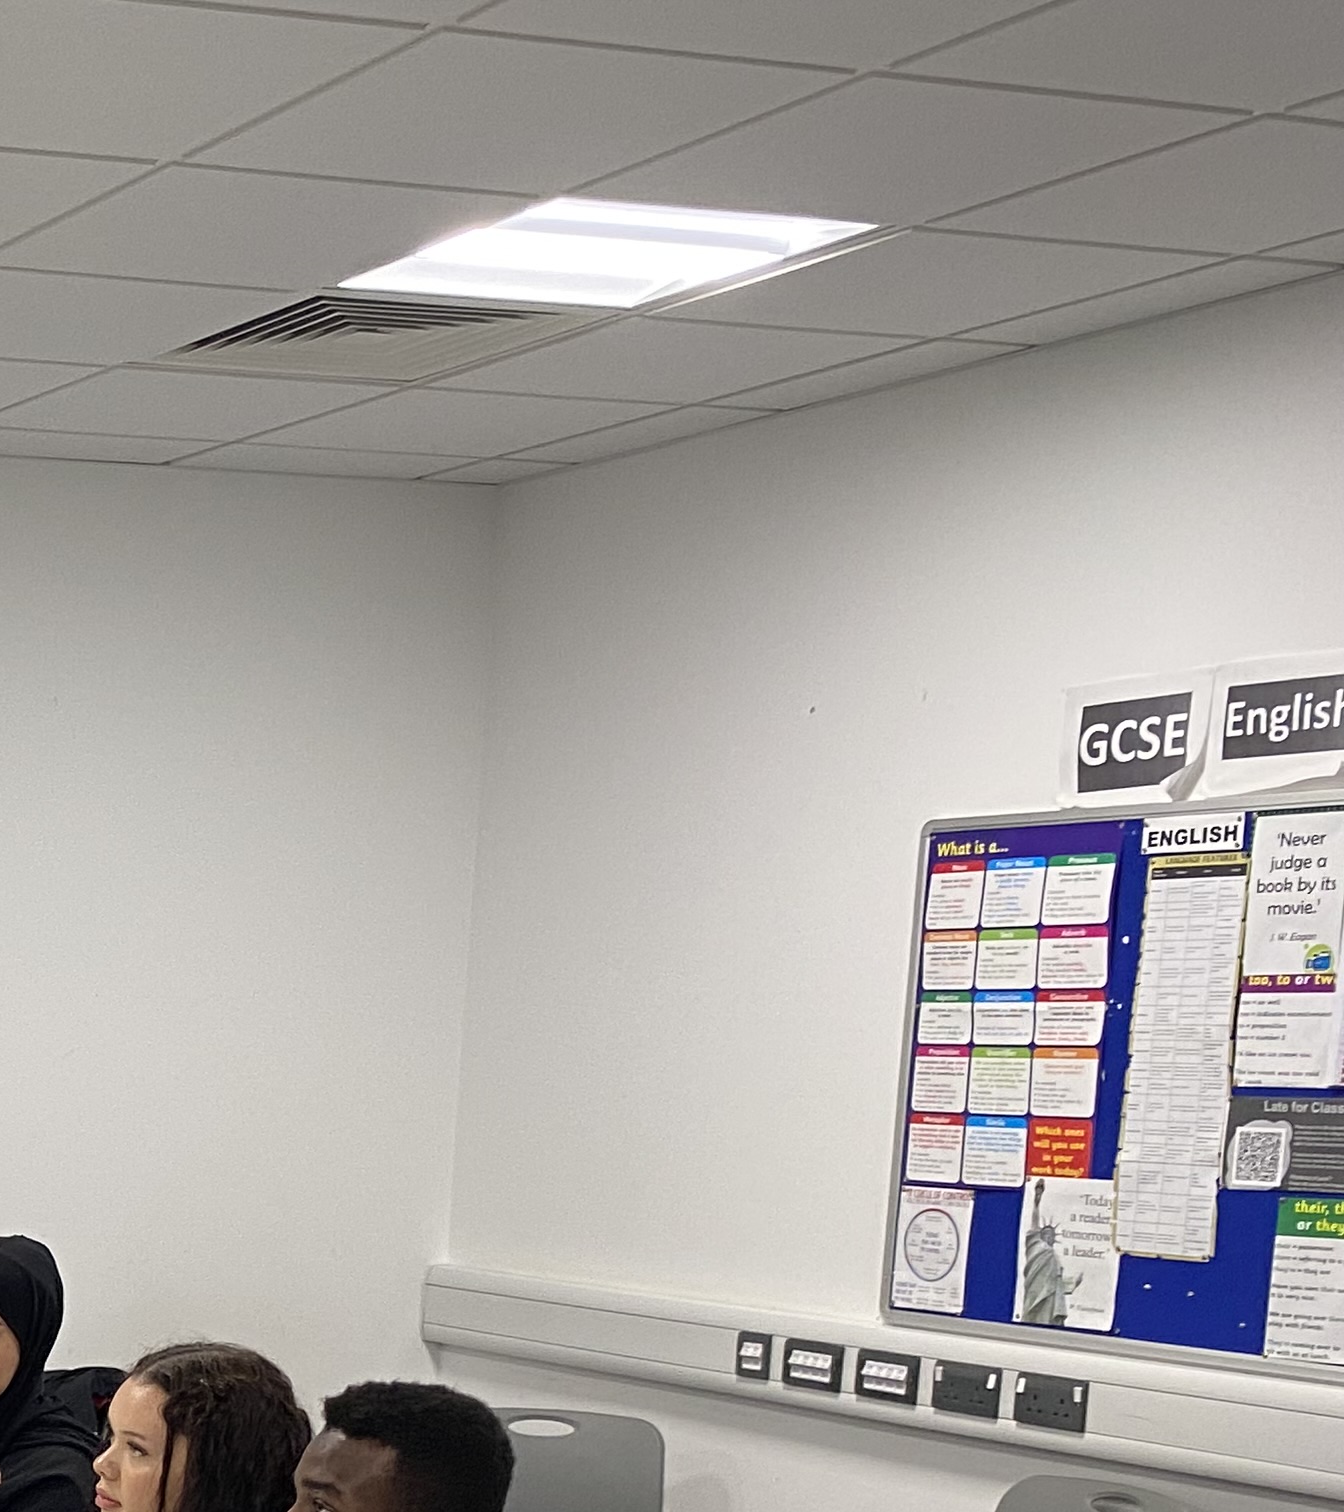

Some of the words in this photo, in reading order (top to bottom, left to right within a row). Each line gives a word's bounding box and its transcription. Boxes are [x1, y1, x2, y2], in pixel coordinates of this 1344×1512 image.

[1080, 712, 1188, 766] GCSE
[1147, 825, 1239, 848] ENGLISH
[1277, 832, 1327, 847] 'Never
[937, 843, 971, 856] What
[974, 840, 985, 854] is
[1269, 855, 1312, 873] judge
[1317, 857, 1328, 867] a
[1256, 877, 1293, 894] book
[1297, 877, 1316, 894] by
[1321, 876, 1337, 890] its
[1267, 899, 1321, 915] movie.'
[1277, 976, 1290, 985] to
[1295, 976, 1311, 985] or
[1314, 975, 1335, 985] tw
[1264, 1100, 1289, 1112] Late
[1292, 1101, 1309, 1112] for
[1294, 1200, 1330, 1216] their,
[1070, 1213, 1076, 1222] a
[1296, 1220, 1312, 1230] or
[1061, 1229, 1111, 1242] tomorrow
[1063, 1247, 1070, 1256] a
